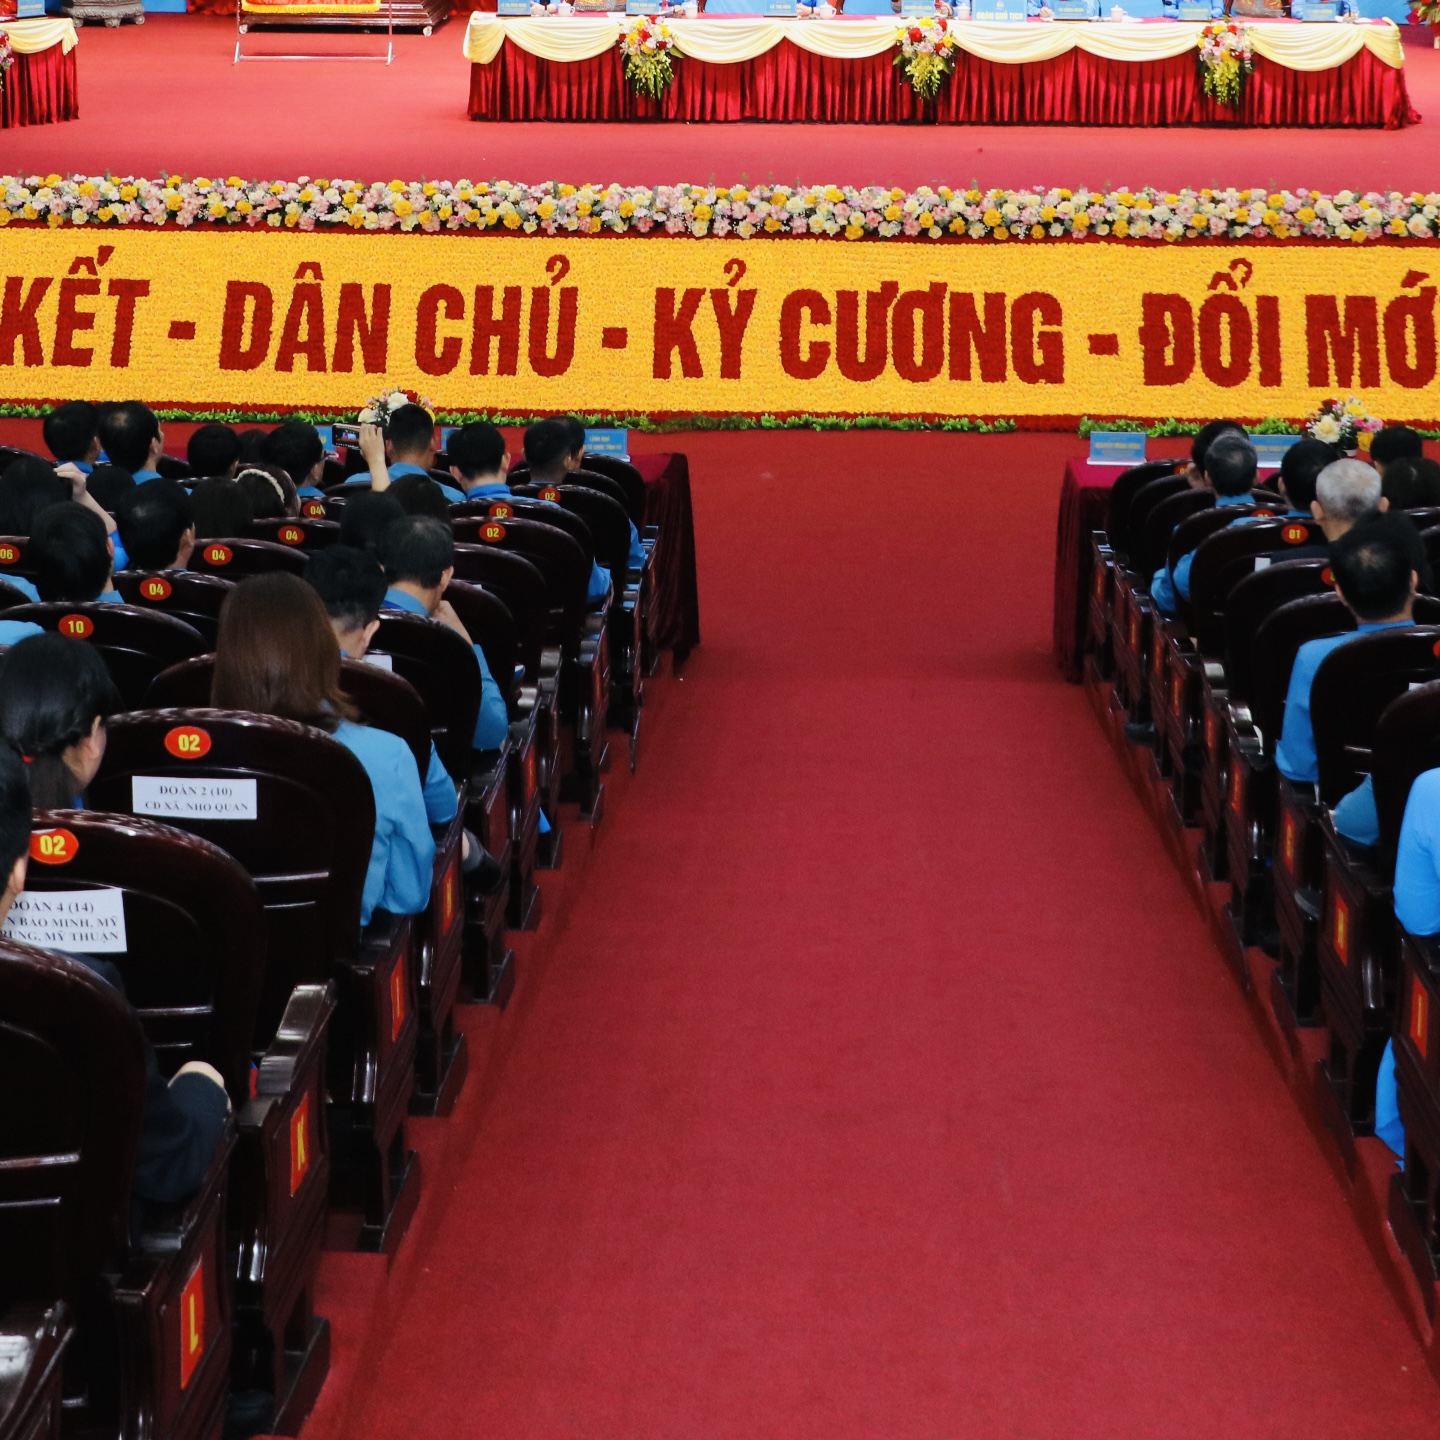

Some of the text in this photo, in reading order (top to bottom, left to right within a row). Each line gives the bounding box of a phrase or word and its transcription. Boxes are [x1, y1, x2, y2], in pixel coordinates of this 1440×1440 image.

[218, 262, 403, 373] DÂN
[416, 254, 581, 378] CHỦ
[652, 256, 753, 380] KỶ
[779, 279, 1064, 384] CƯƠNG
[1139, 257, 1282, 386] ĐỔI
[487, 528, 499, 537] 02
[1289, 529, 1301, 539] 01
[149, 583, 164, 595] 04
[68, 621, 84, 633] 10
[178, 734, 200, 751] 02
[159, 784, 233, 797] ĐOÀN 2 (10)
[186, 802, 248, 813] NHO QUAN
[40, 835, 66, 855] 02
[57, 902, 94, 913] 4 (14)
[190, 1293, 199, 1354] L
